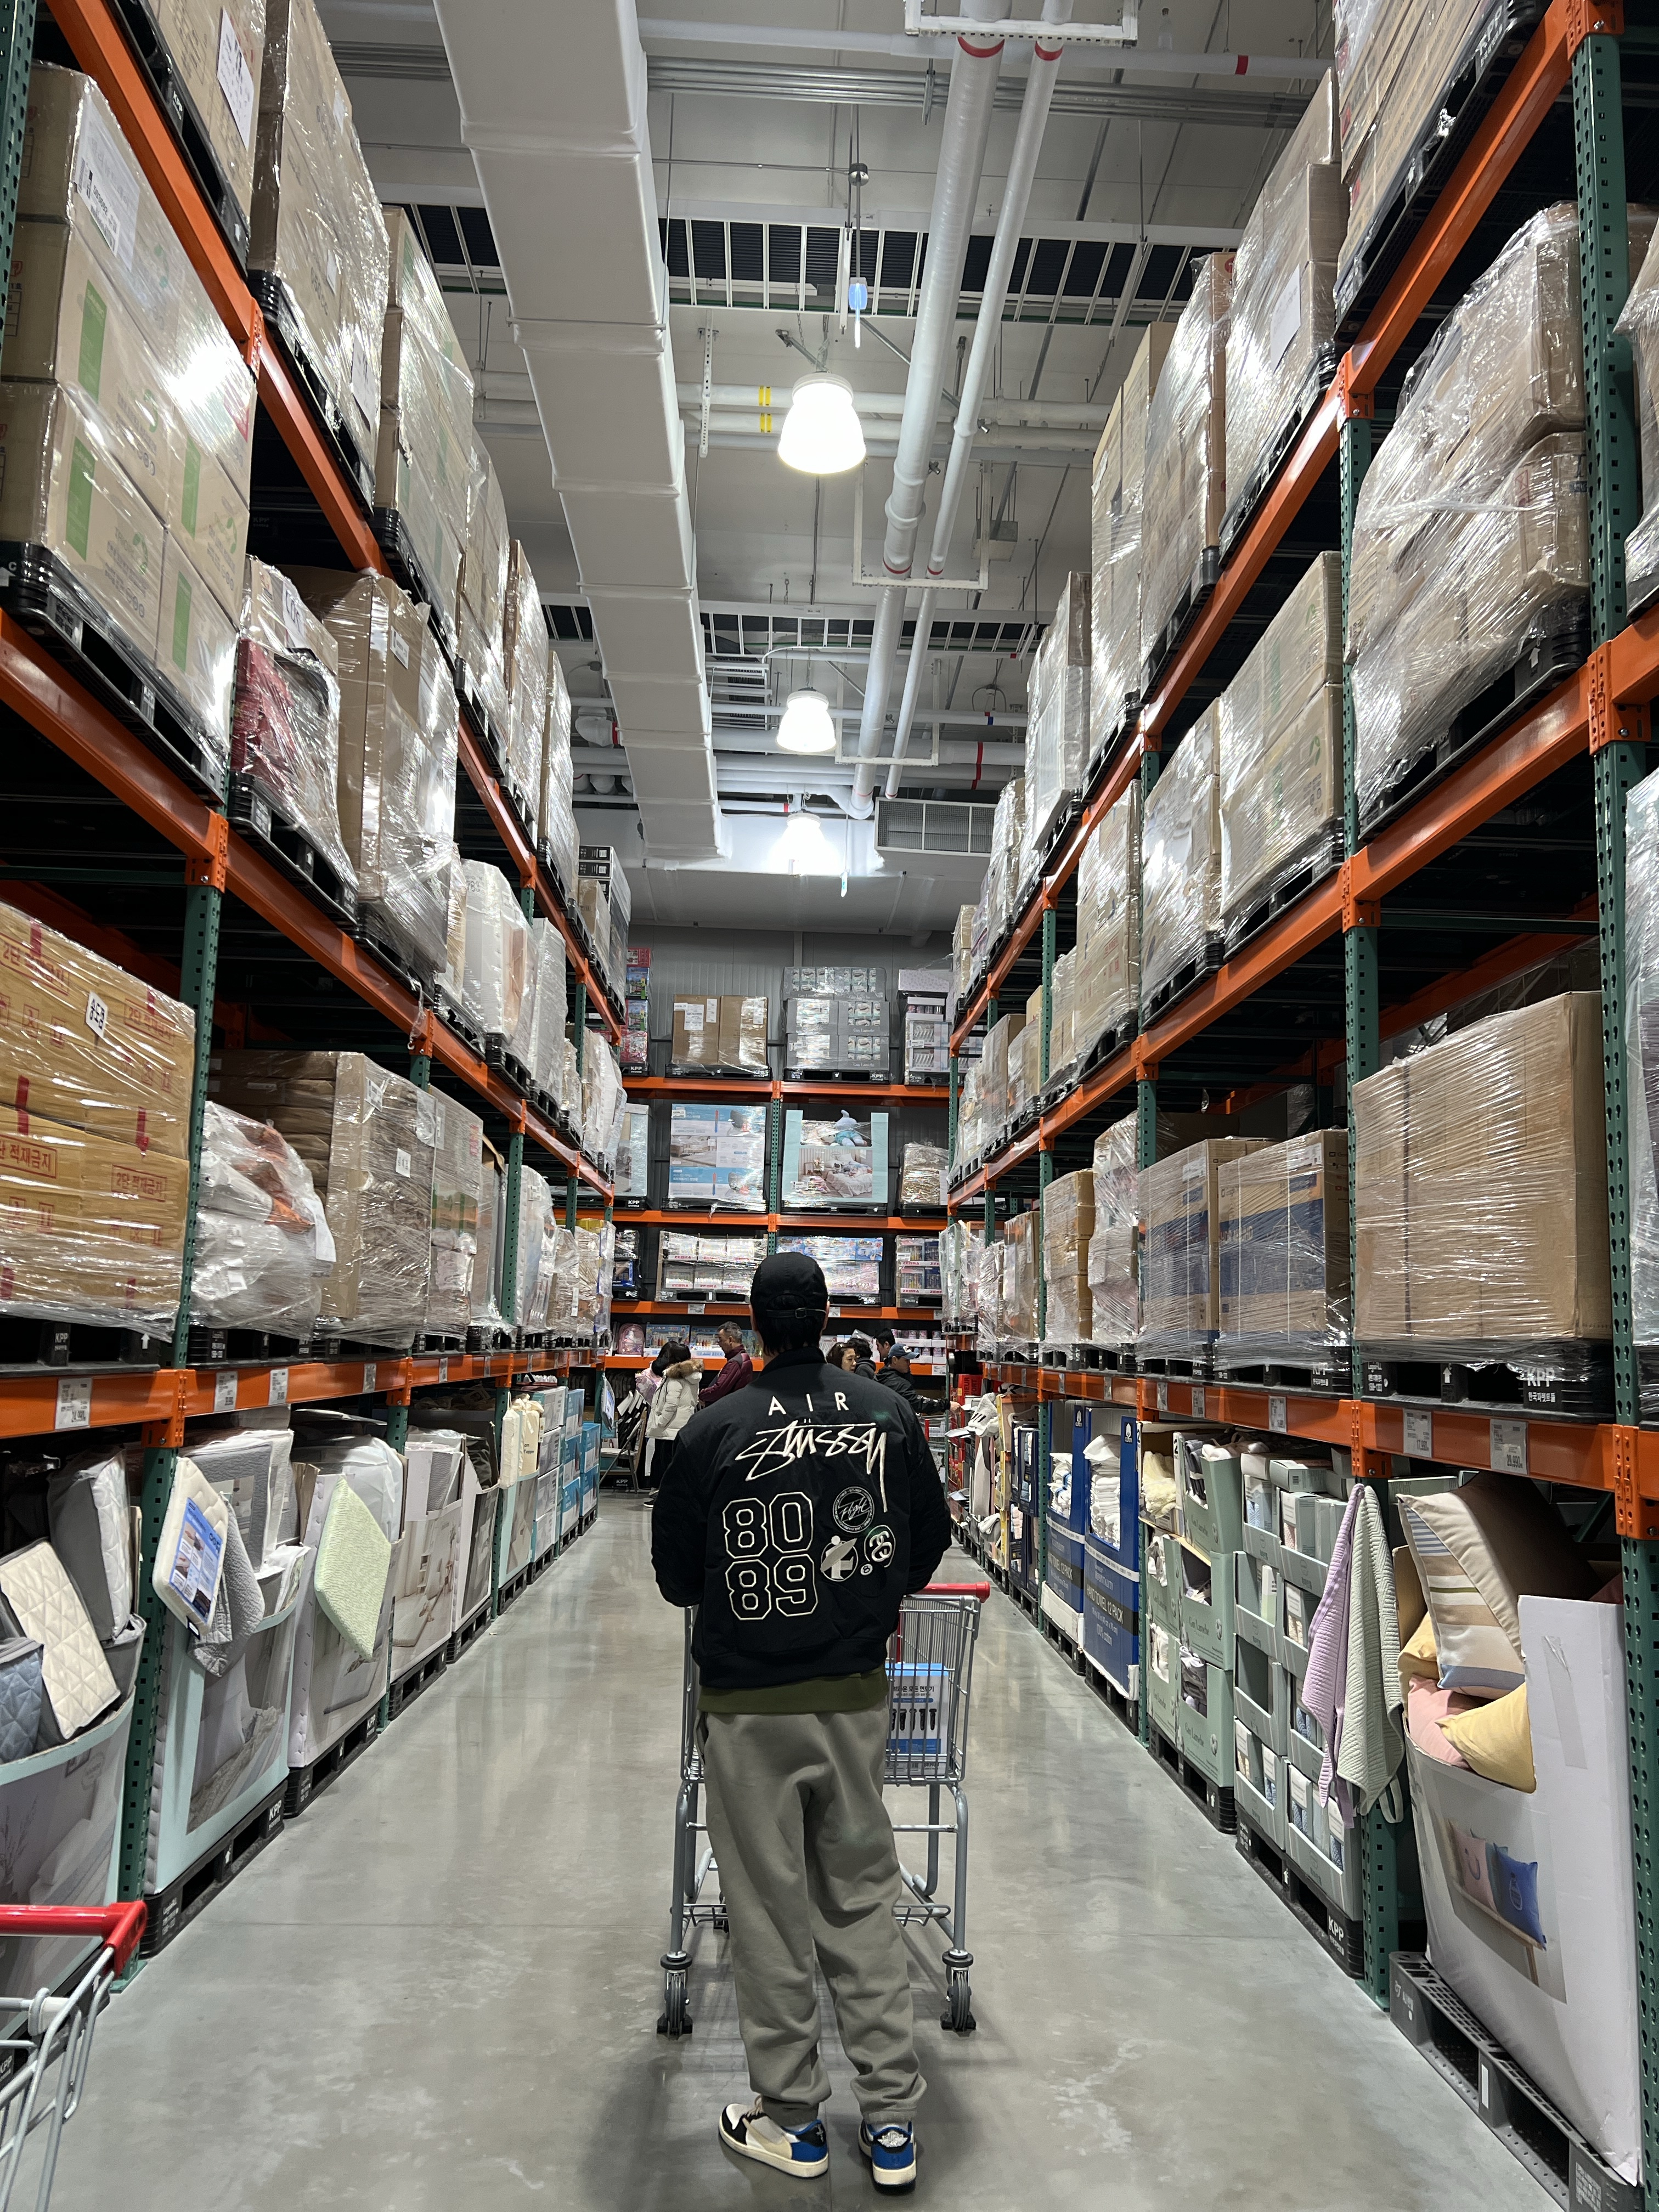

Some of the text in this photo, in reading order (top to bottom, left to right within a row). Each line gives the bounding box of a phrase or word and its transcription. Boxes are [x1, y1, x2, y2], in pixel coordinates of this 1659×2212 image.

[9, 1144, 52, 1172] 적재금지
[55, 1333, 69, 1343] KPP
[768, 1392, 849, 1416] AIR
[1173, 1438, 1178, 1454] 2
[722, 1491, 814, 1559] 80
[863, 1565, 871, 1573] 8
[725, 1554, 819, 1621] 89
[1094, 1589, 1107, 1612] TOWEL
[1107, 1599, 1112, 1616] 12
[1112, 1603, 1124, 1624] PACK
[366, 1714, 376, 1731] KPP
[268, 1799, 283, 1821] KPP
[1328, 1915, 1344, 1941] KPP
